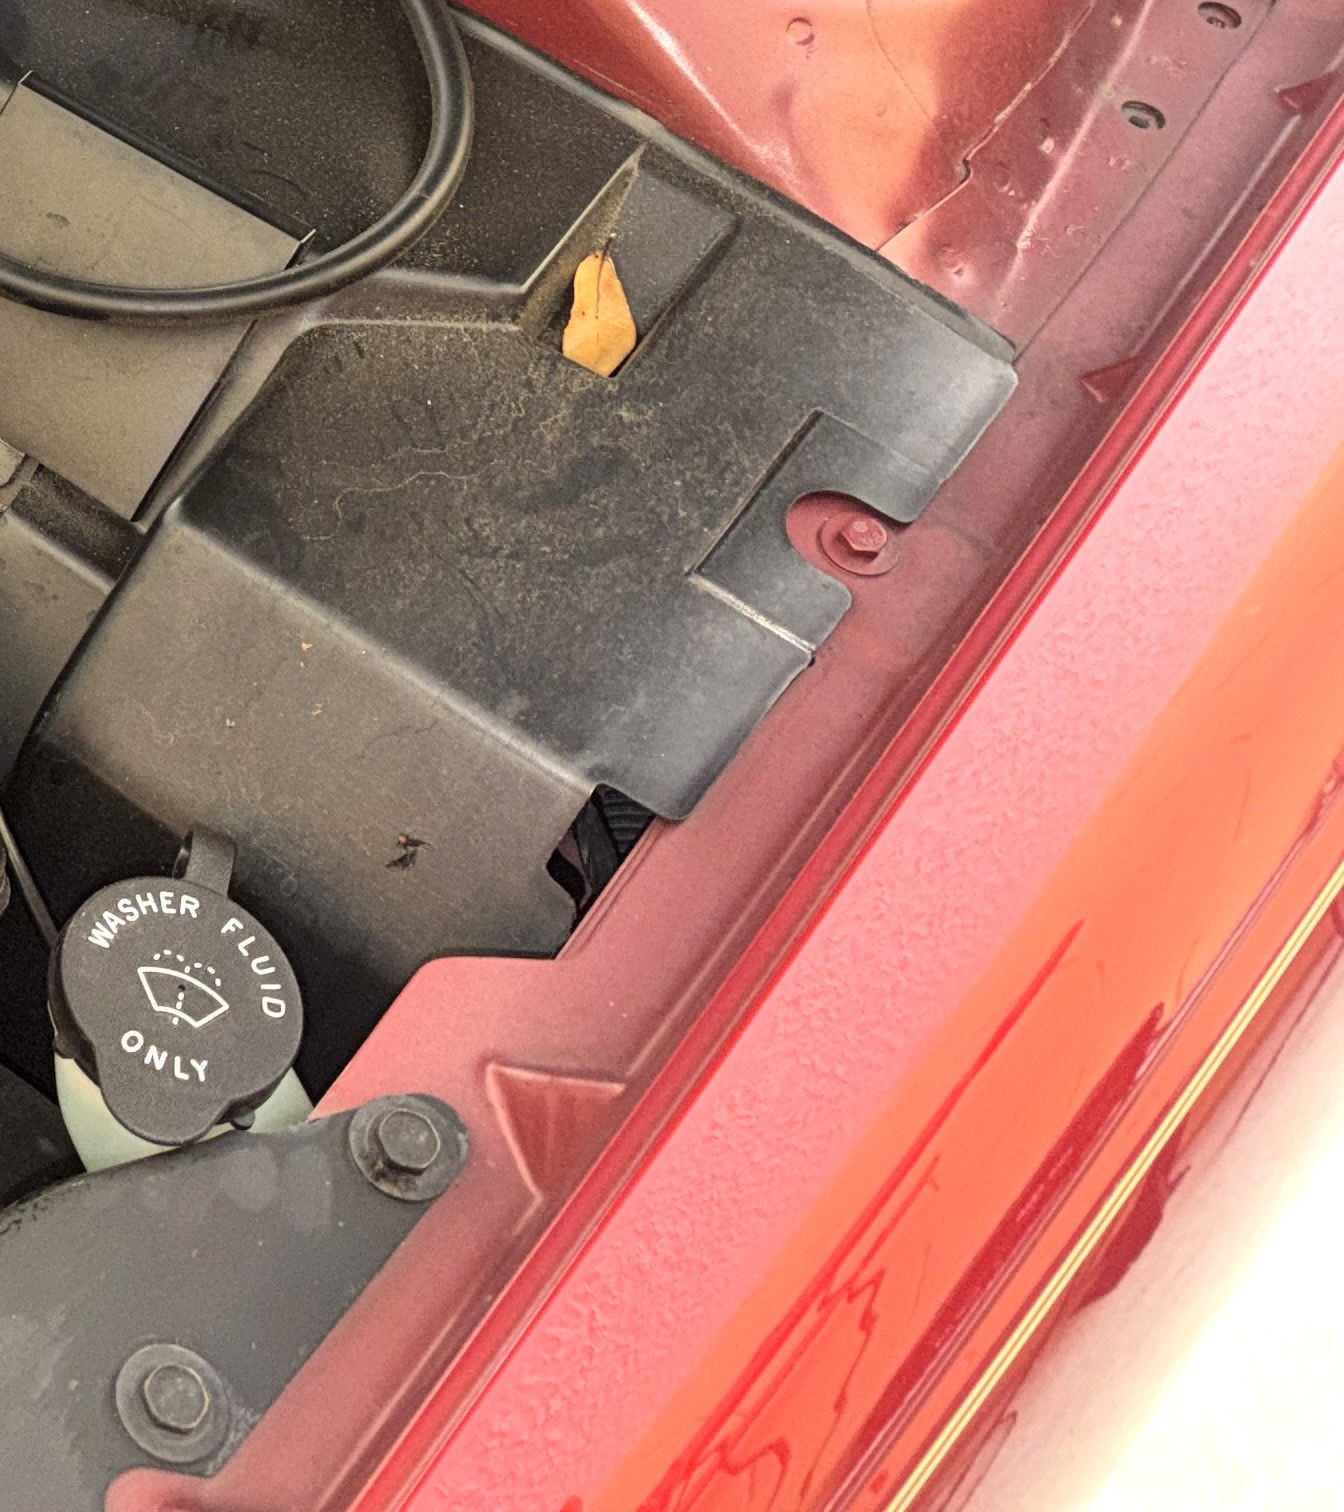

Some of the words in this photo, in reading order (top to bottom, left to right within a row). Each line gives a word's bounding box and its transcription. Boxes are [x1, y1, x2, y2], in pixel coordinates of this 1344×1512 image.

[88, 891, 200, 949] WASHER
[220, 917, 286, 1018] FLUID
[121, 1030, 208, 1082] ONLY
